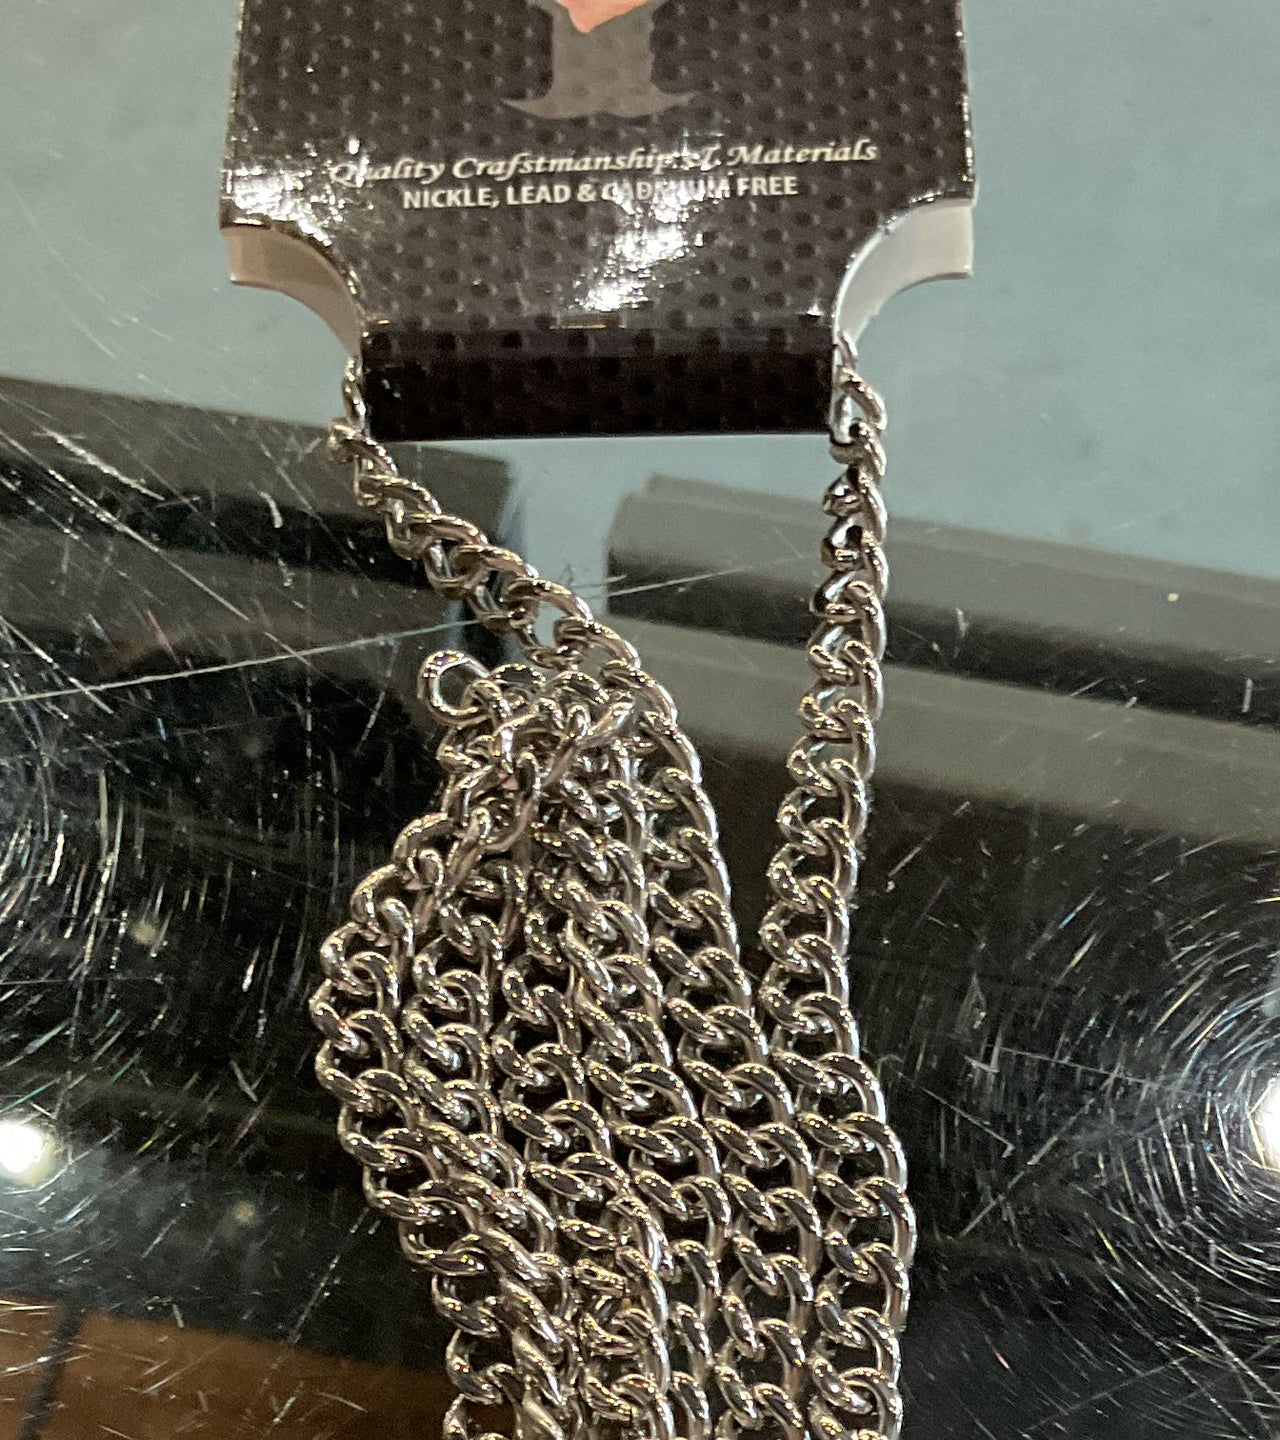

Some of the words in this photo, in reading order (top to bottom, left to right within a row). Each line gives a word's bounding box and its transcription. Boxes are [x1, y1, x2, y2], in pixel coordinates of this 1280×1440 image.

[726, 138, 878, 167] Materials
[402, 187, 500, 209] NICKLE,
[505, 184, 571, 206] LEAD
[576, 183, 596, 203] &
[736, 175, 799, 197] FREE
